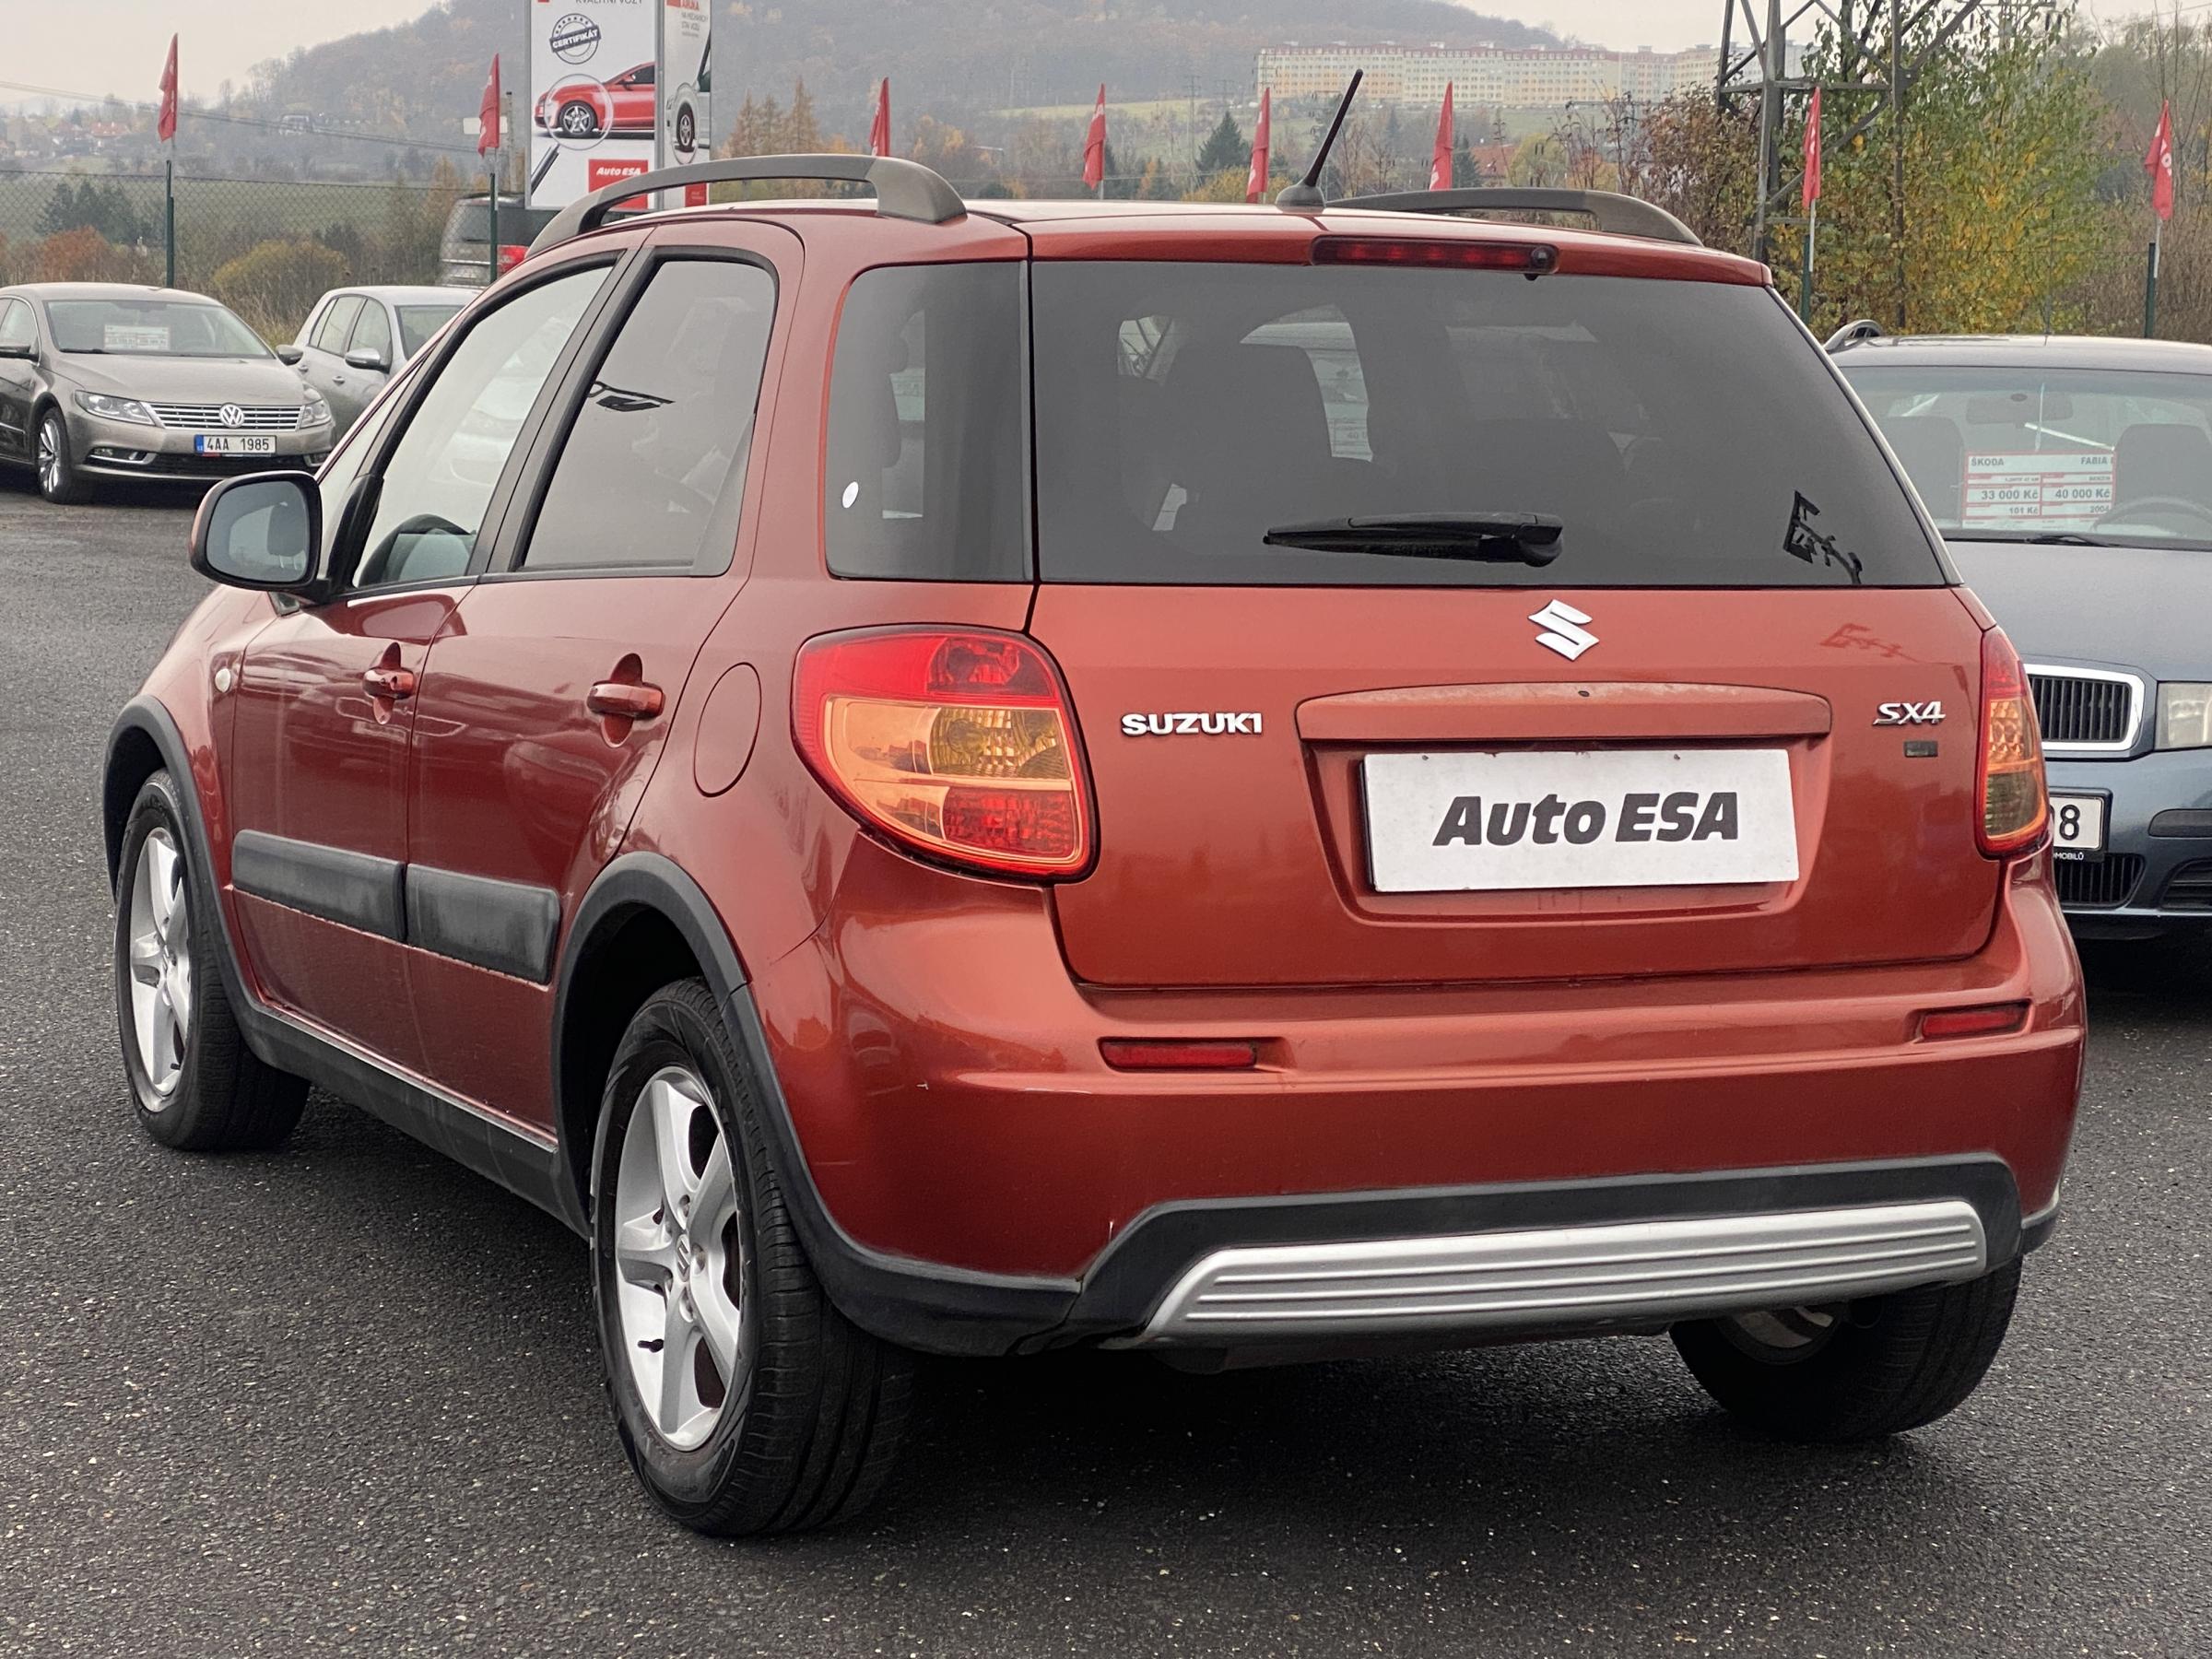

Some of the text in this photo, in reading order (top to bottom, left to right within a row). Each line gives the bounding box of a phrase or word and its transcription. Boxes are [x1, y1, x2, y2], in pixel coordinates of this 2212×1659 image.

[553, 29, 598, 48] CERTIFIKÁT
[595, 167, 641, 176] Auto ESA
[206, 437, 229, 451] 4AA
[240, 438, 269, 451] 1985
[1971, 457, 2004, 466] ŠKODA
[2080, 456, 2108, 465] FABIA
[1982, 489, 2039, 500] 33 000 Kč
[2055, 488, 2110, 499] 40 000 Kč
[1872, 700, 1947, 725] SX4
[1121, 712, 1264, 736] SUZUKI
[1432, 792, 1738, 846] Auto ESA
[2049, 804, 2080, 841] 8
[2053, 852, 2085, 861] MOBILŮ
